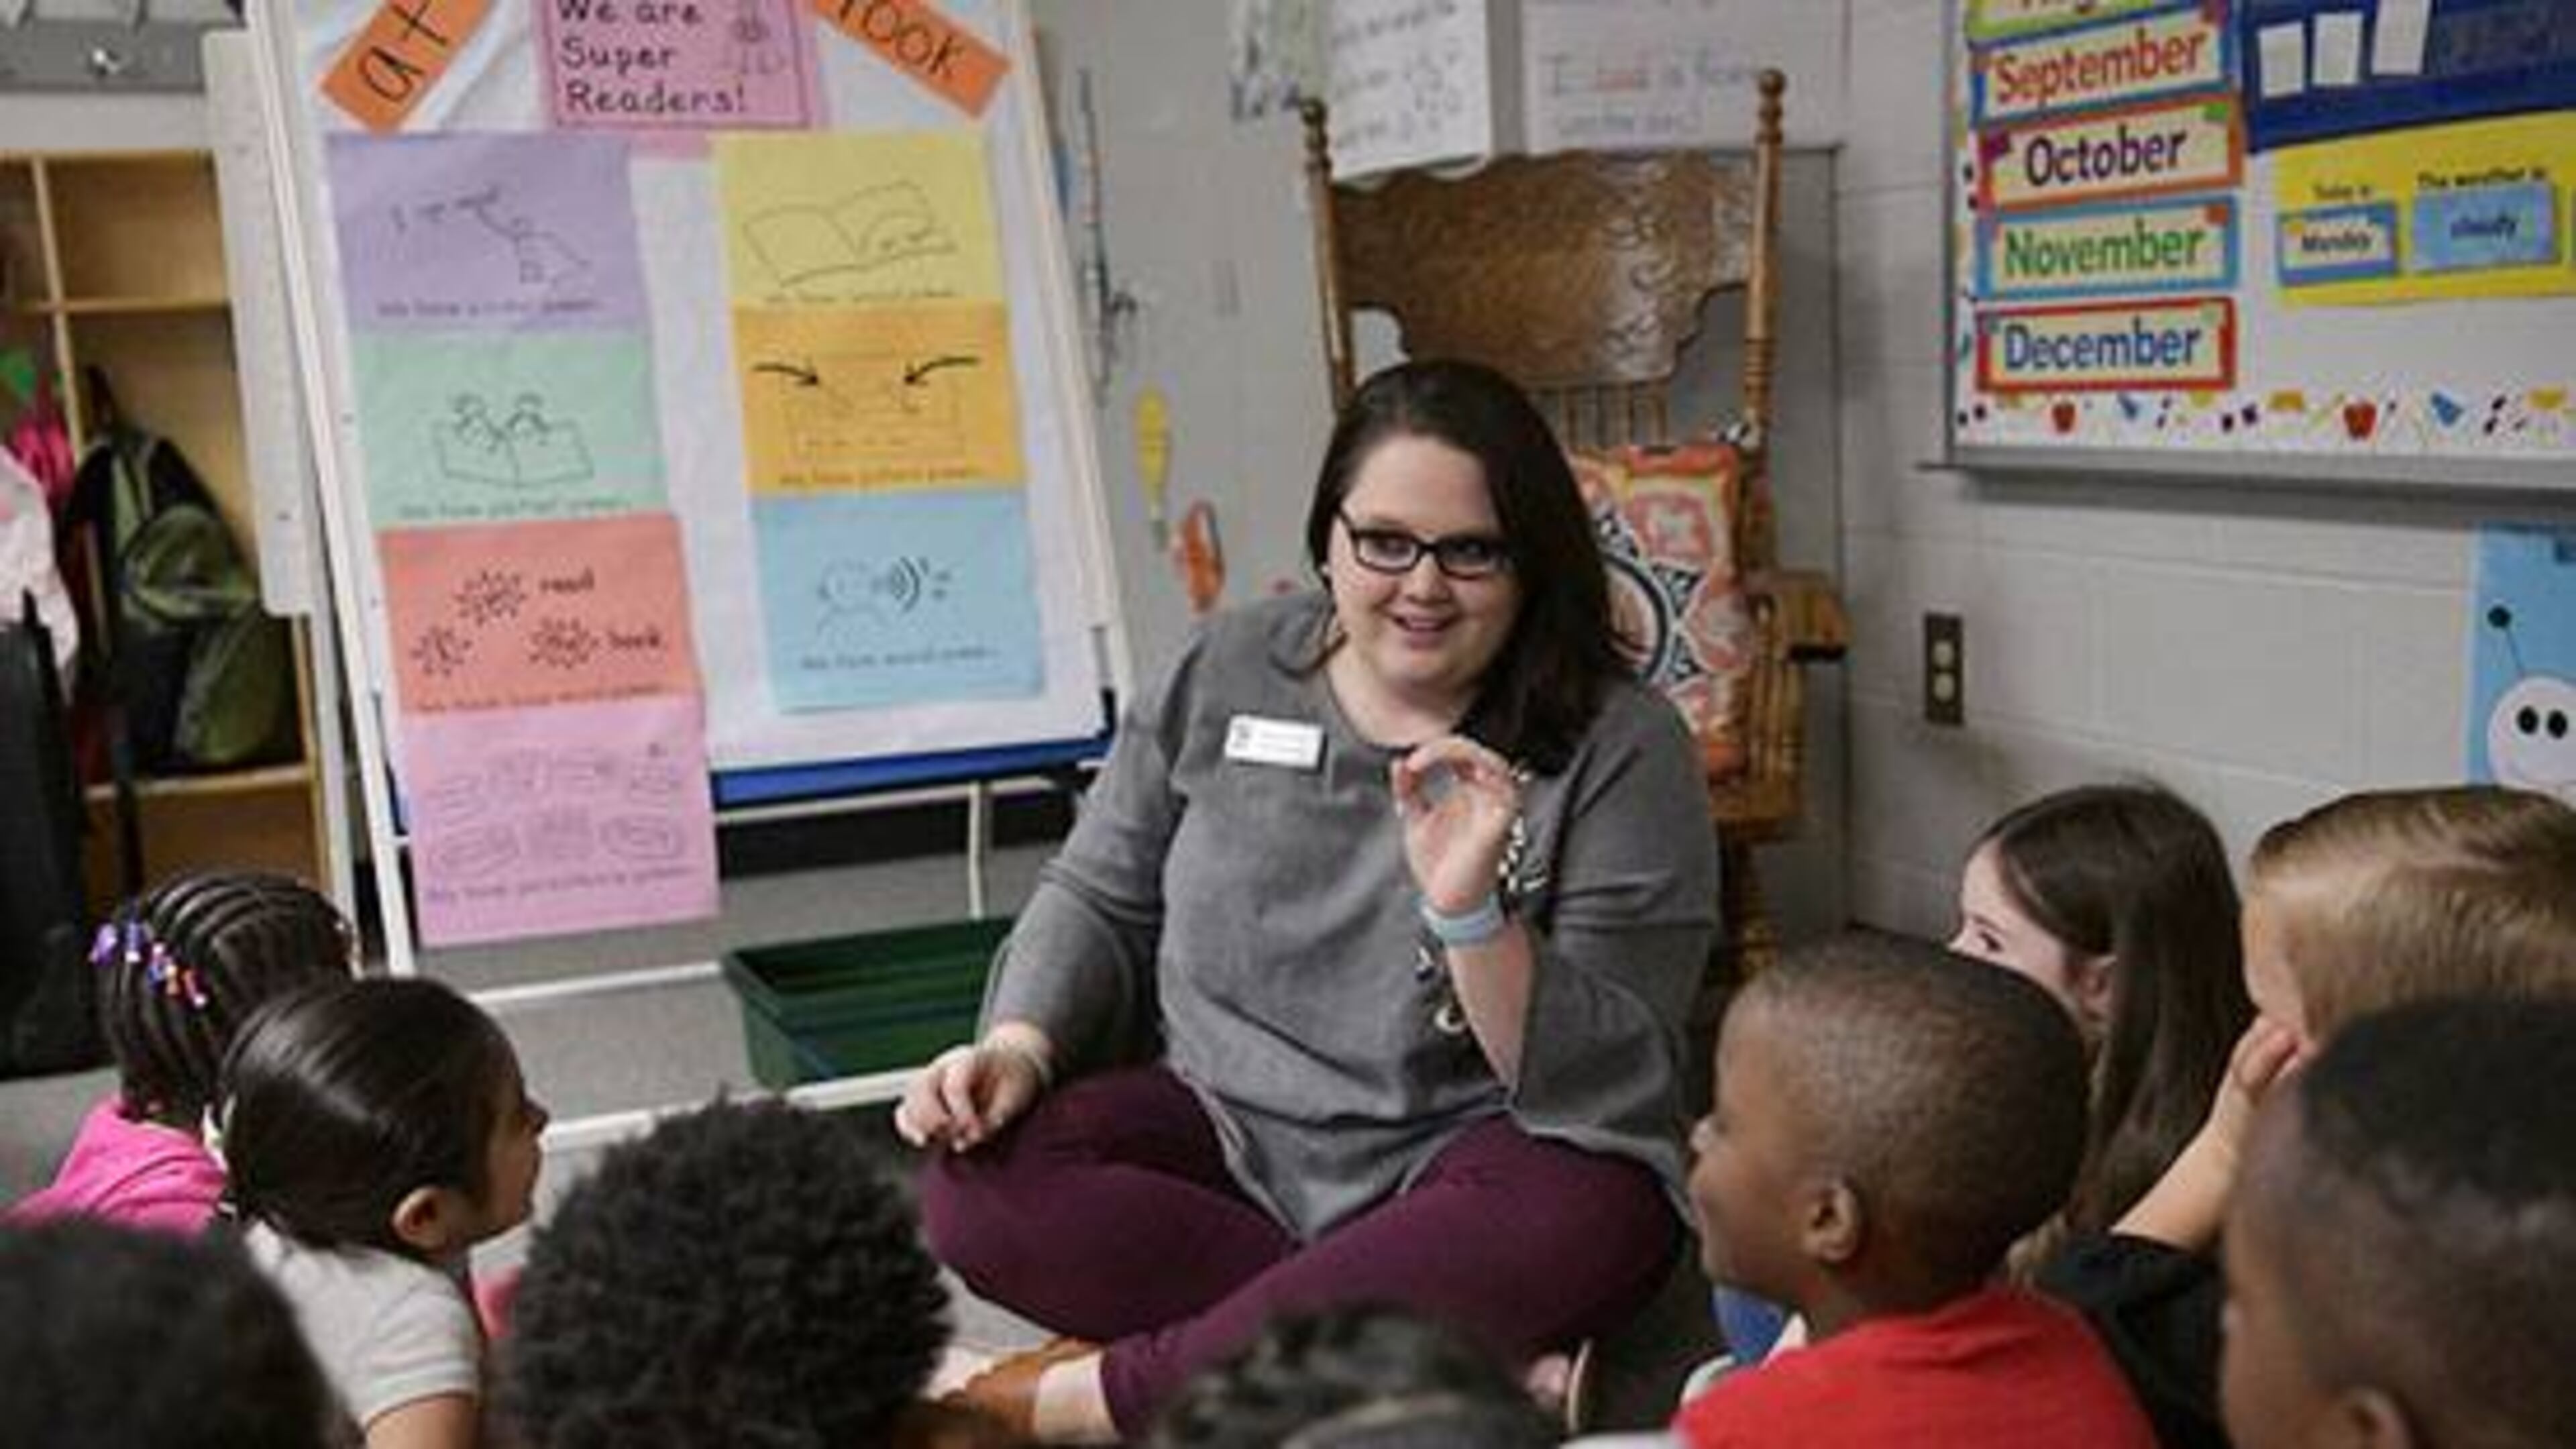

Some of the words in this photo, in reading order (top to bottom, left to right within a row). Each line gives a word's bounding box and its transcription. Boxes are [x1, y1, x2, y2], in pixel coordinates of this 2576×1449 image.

[556, 0, 618, 23] We
[635, 3, 702, 24] are
[561, 36, 676, 76] Super
[1994, 27, 2208, 109] September
[565, 78, 746, 115] Readers!
[2025, 125, 2187, 186] October
[2004, 219, 2204, 277] November
[2004, 317, 2201, 371] December
